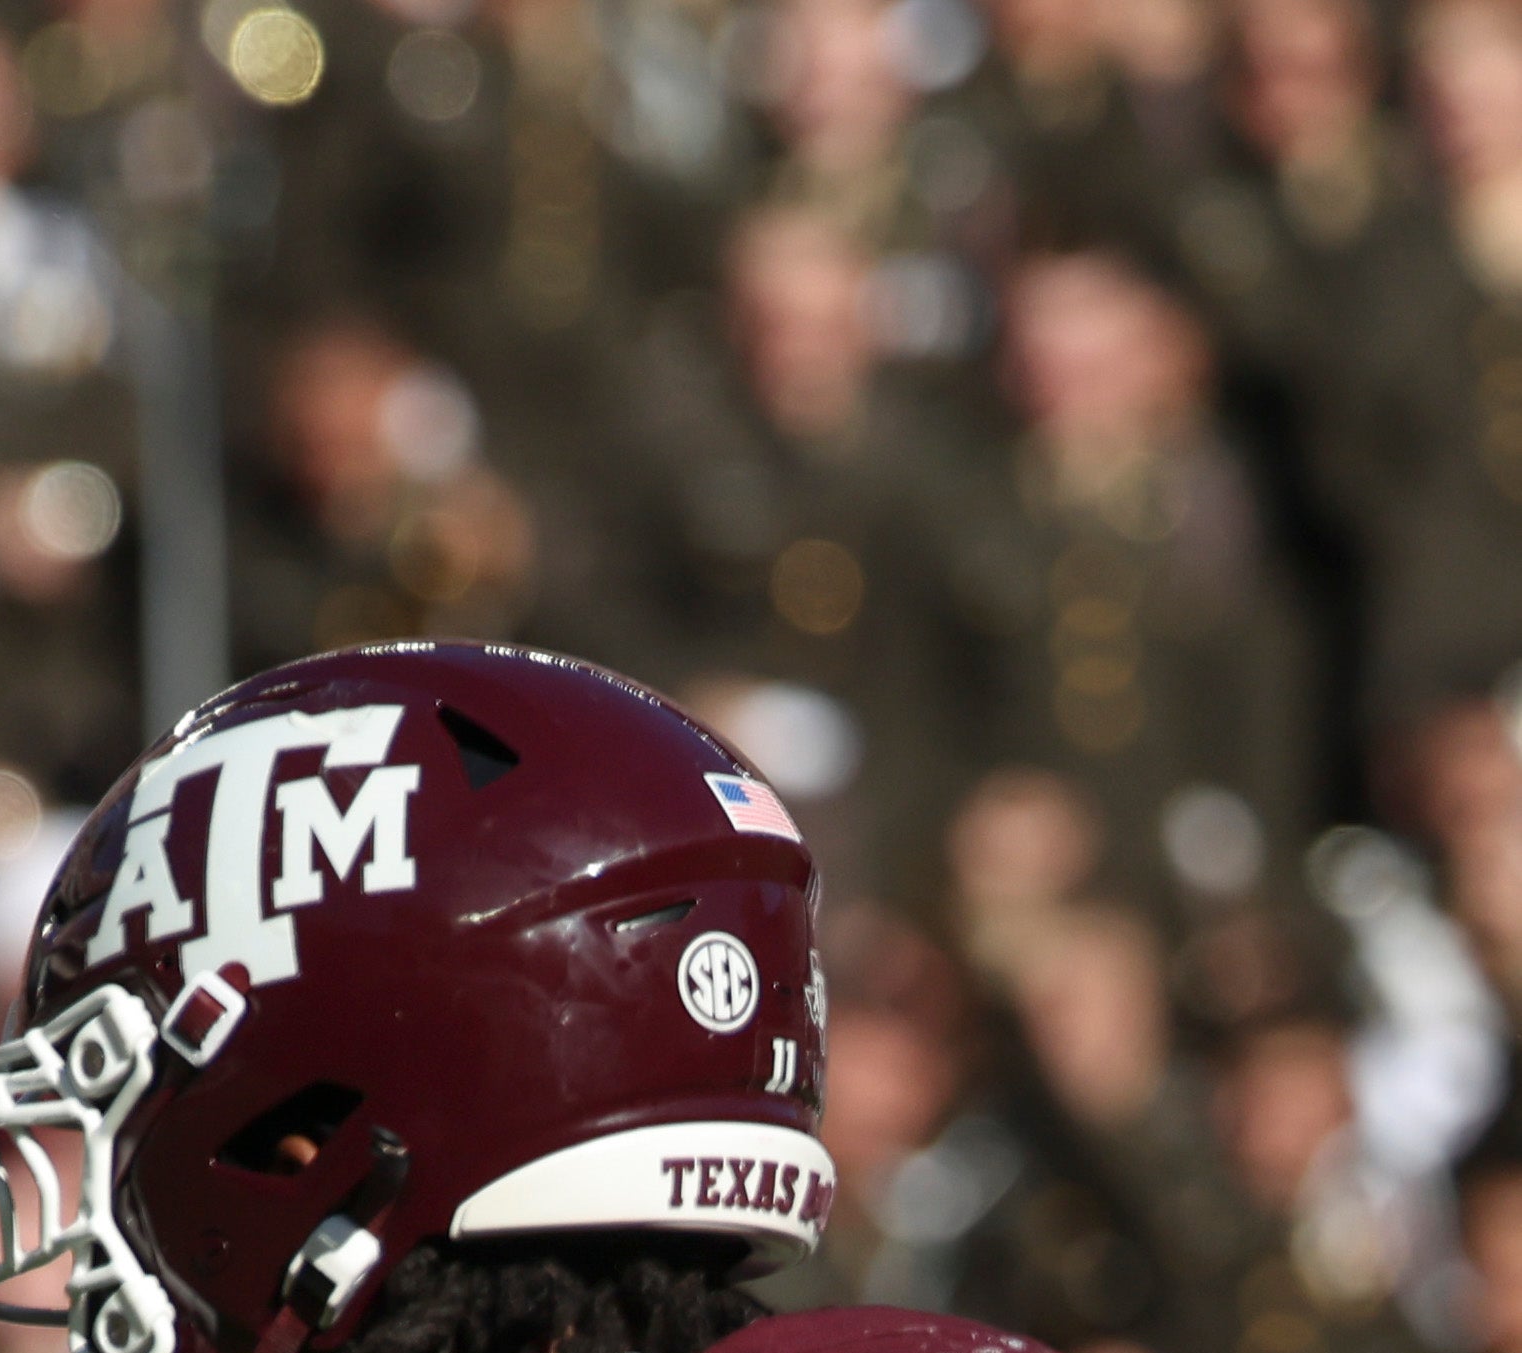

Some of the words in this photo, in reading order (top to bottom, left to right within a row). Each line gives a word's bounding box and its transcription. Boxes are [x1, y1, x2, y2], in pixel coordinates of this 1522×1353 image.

[687, 940, 754, 1025] SEC
[764, 1037, 796, 1093] 11
[661, 1157, 800, 1215] TEXAS
